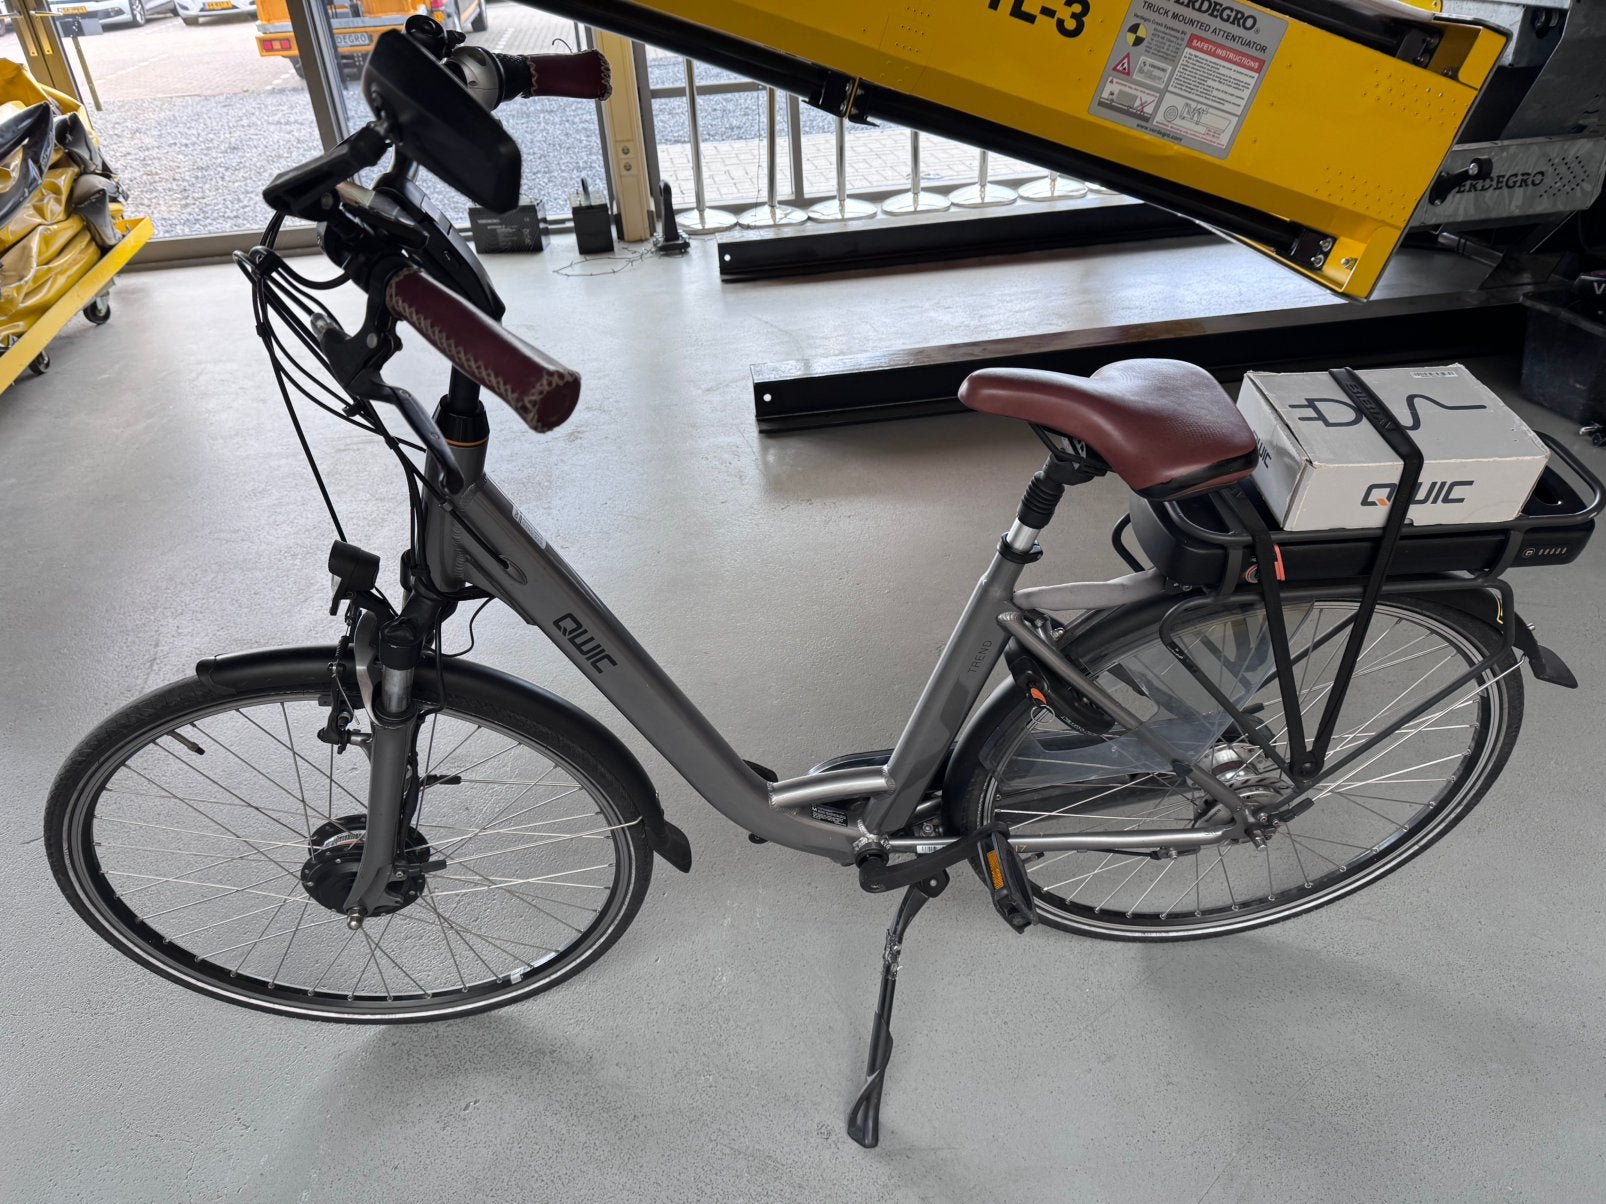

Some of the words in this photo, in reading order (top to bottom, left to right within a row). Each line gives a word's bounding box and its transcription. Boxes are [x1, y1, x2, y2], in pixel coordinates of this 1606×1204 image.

[1141, 1, 1169, 20] TRUCK
[1170, 11, 1211, 32] MOUNTED
[1211, 26, 1268, 54] ATTENTUATOR
[1191, 38, 1216, 55] SAFETY
[1215, 47, 1260, 70] INSTRUCTIONS
[1456, 171, 1545, 194] ERDEGRO
[552, 612, 618, 674] QWIC
[967, 640, 993, 673] TREND
